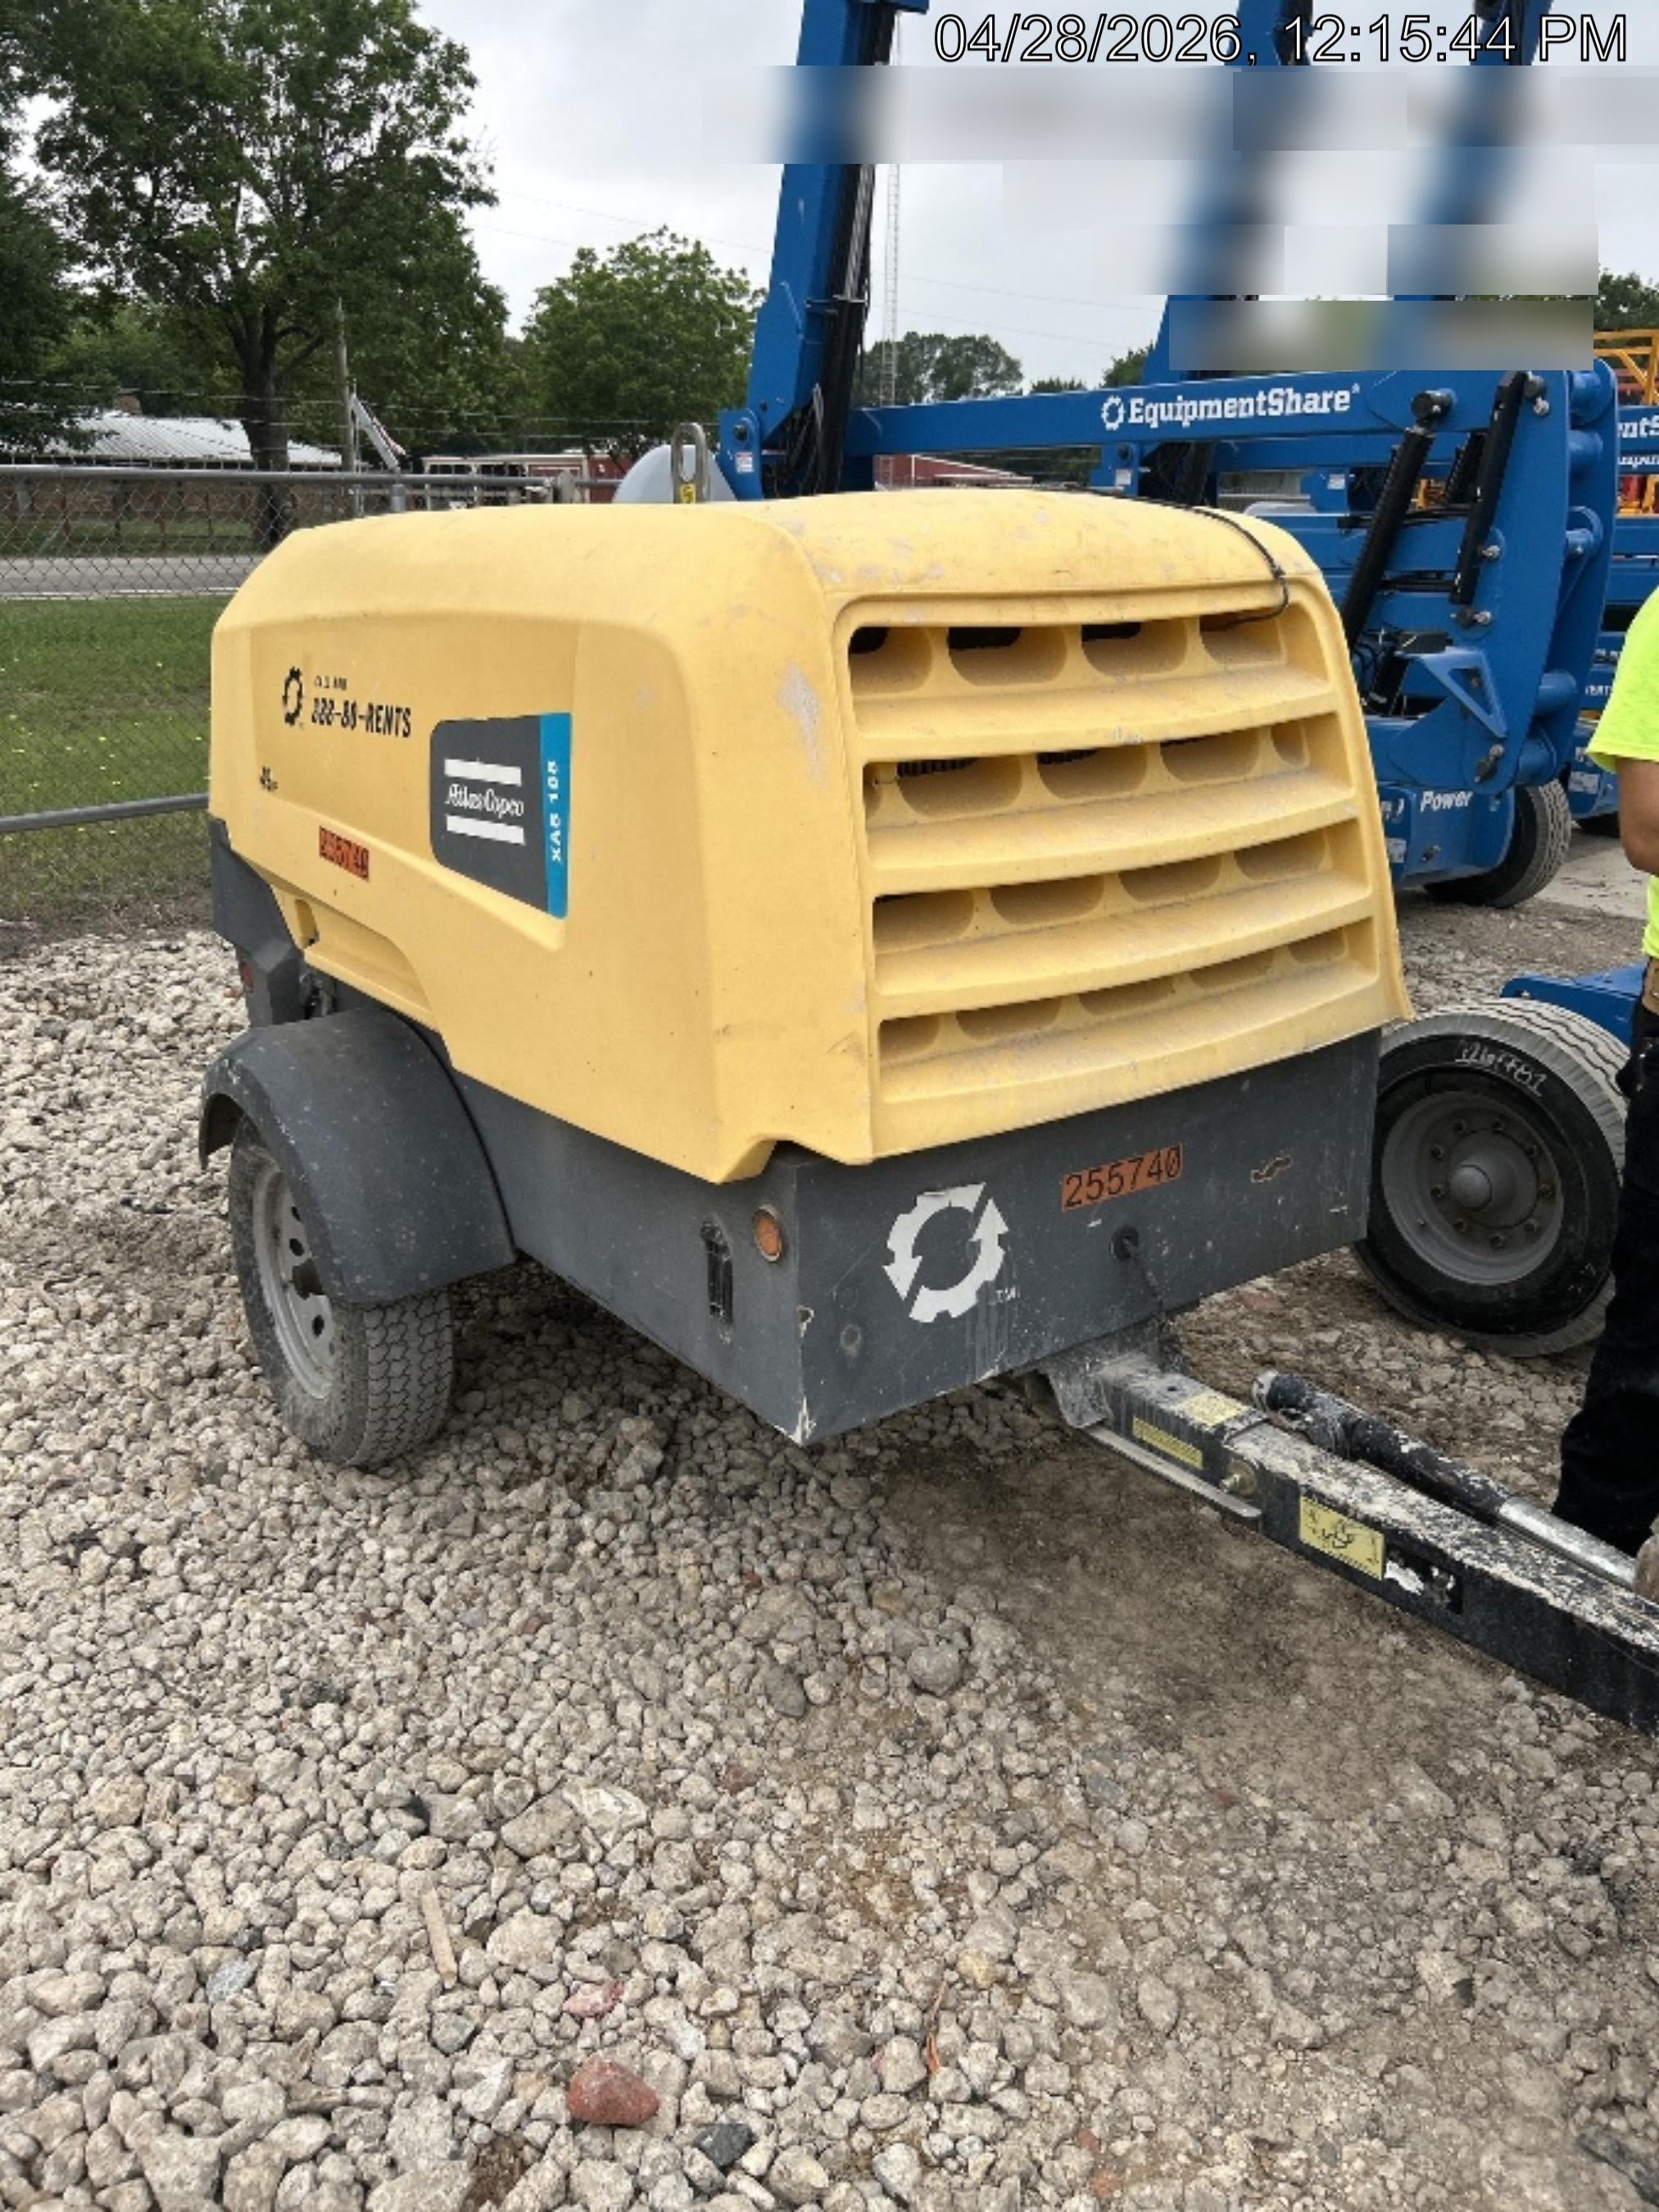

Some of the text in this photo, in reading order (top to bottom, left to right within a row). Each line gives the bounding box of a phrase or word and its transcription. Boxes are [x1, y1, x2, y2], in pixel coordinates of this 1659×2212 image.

[1128, 387, 1351, 428] EquipmentShare
[1420, 791, 1473, 812] Power
[1065, 1145, 1181, 1208] 255740
